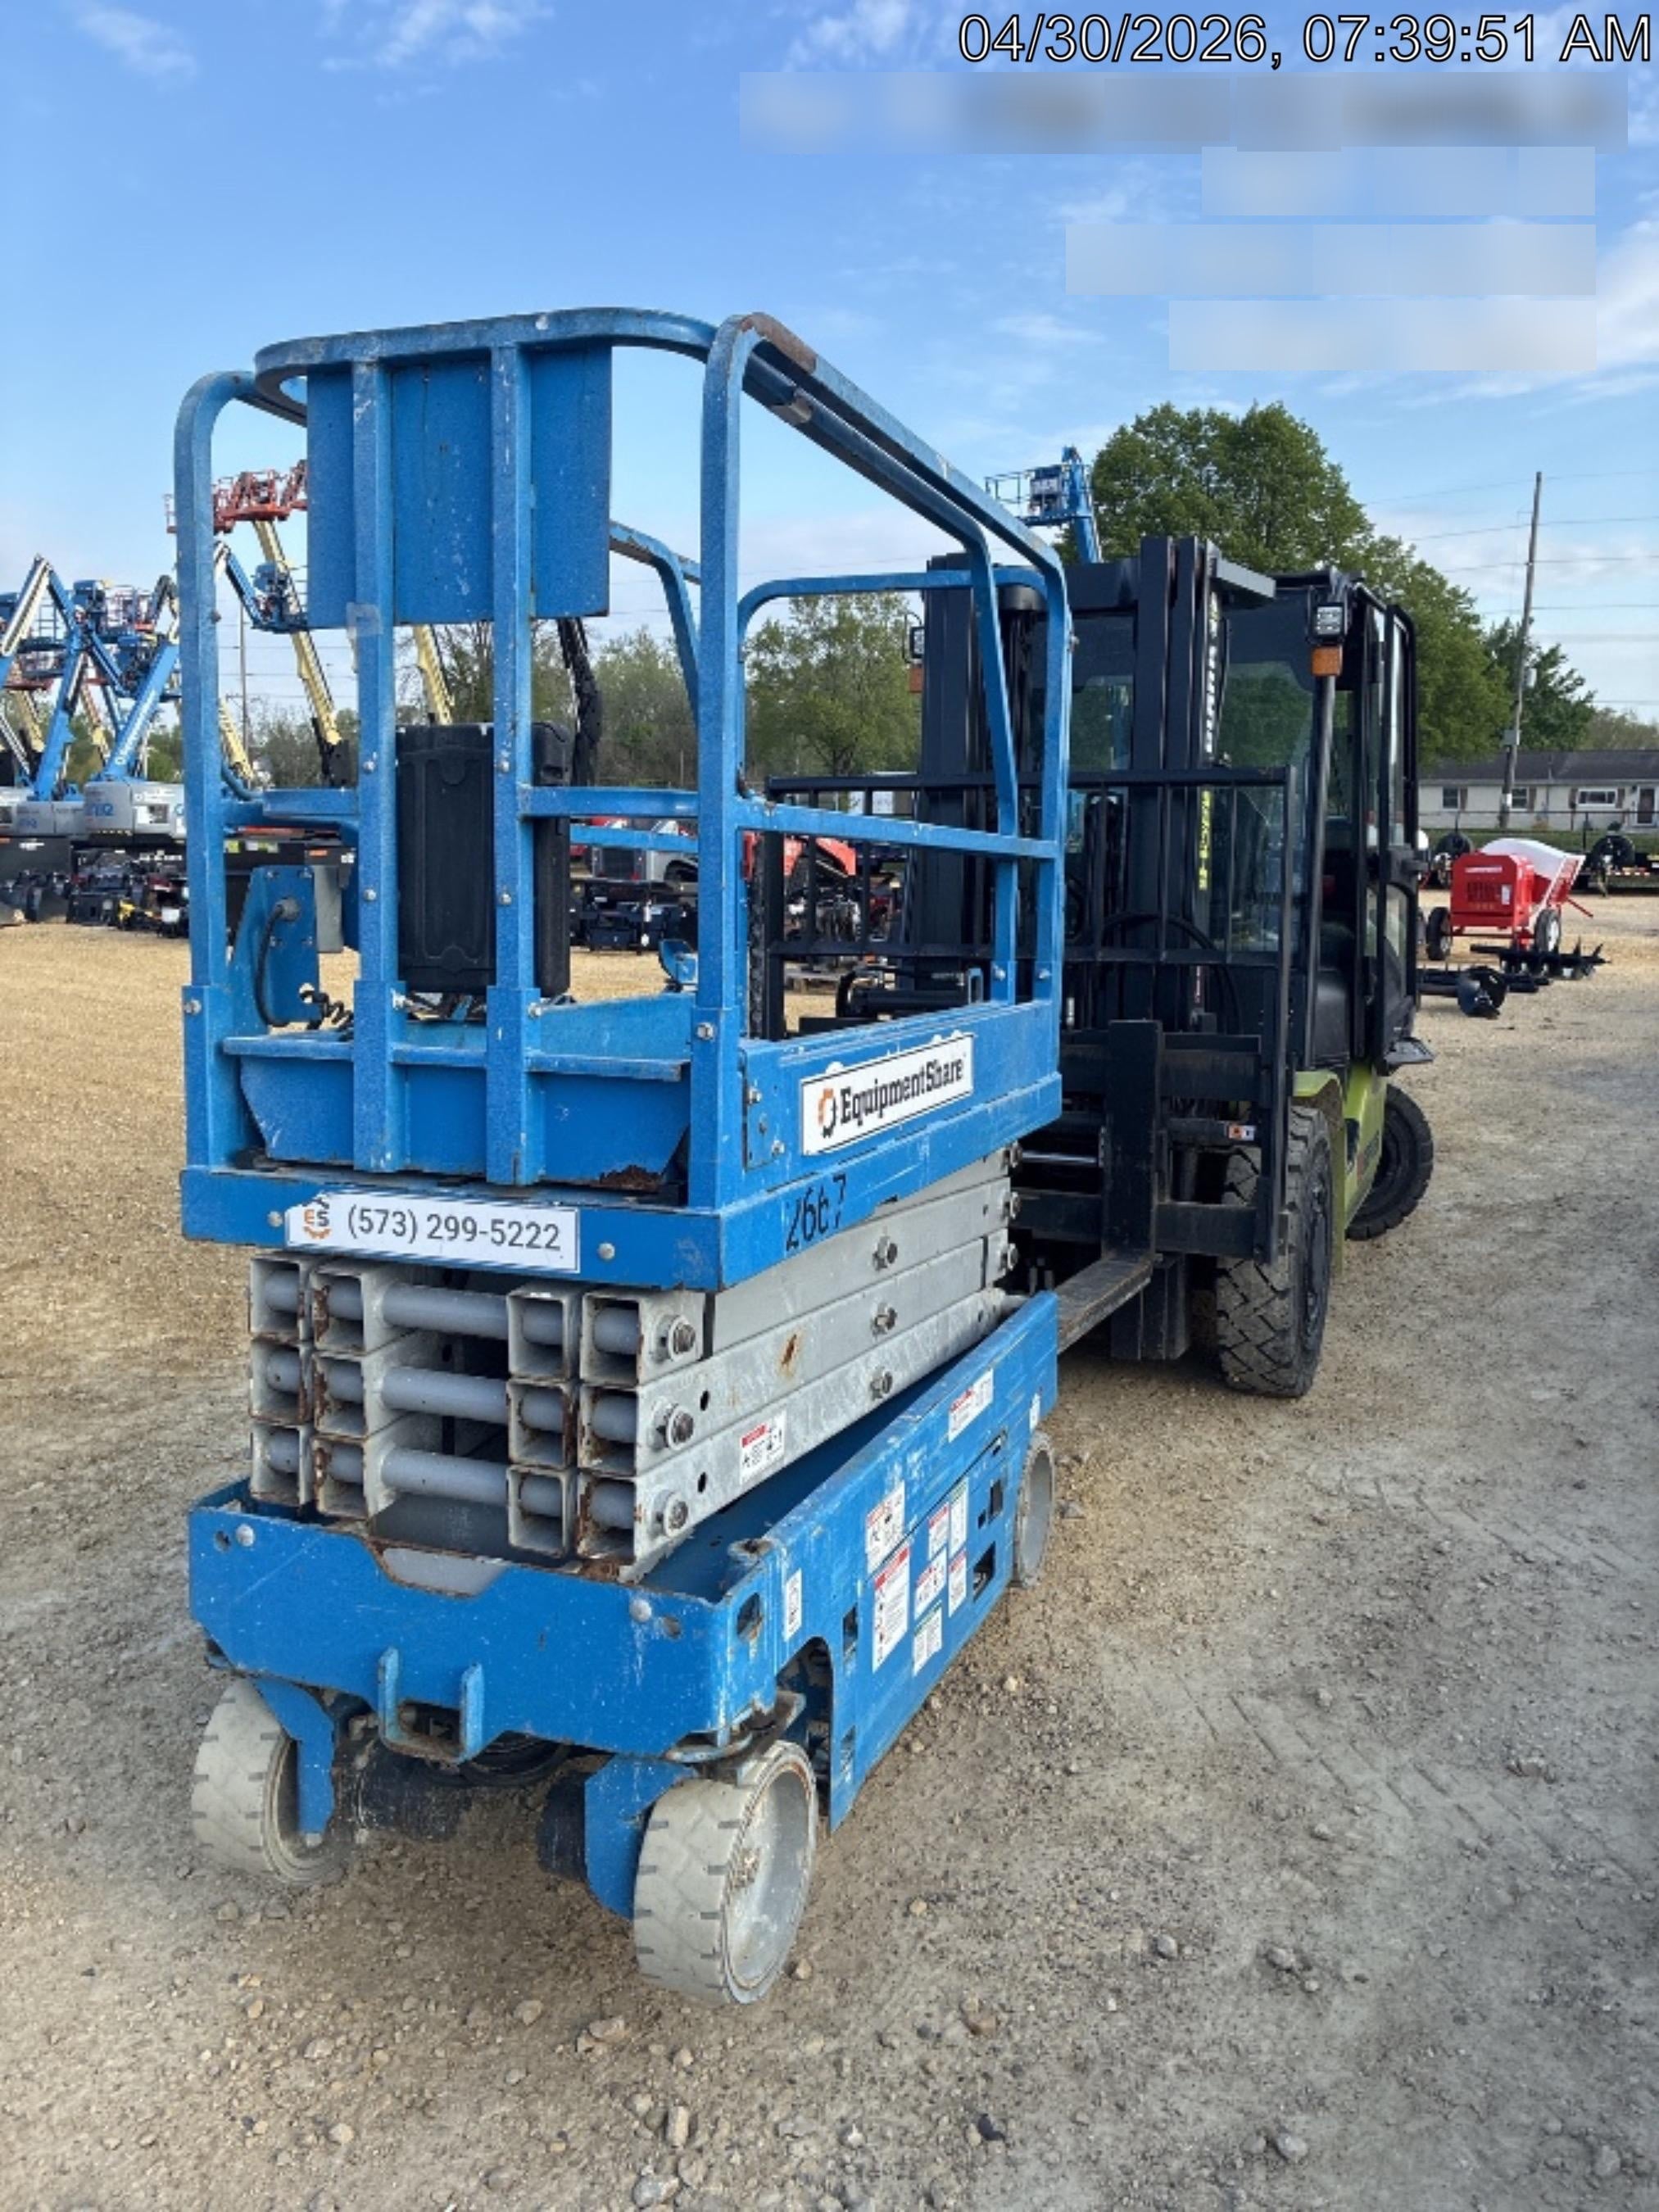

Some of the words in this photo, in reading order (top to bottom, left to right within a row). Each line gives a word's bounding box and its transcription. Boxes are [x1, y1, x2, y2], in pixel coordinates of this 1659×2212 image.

[840, 1058, 963, 1126] EquipmentShare
[347, 1203, 419, 1244] (573)
[426, 1213, 561, 1251] 299-5222
